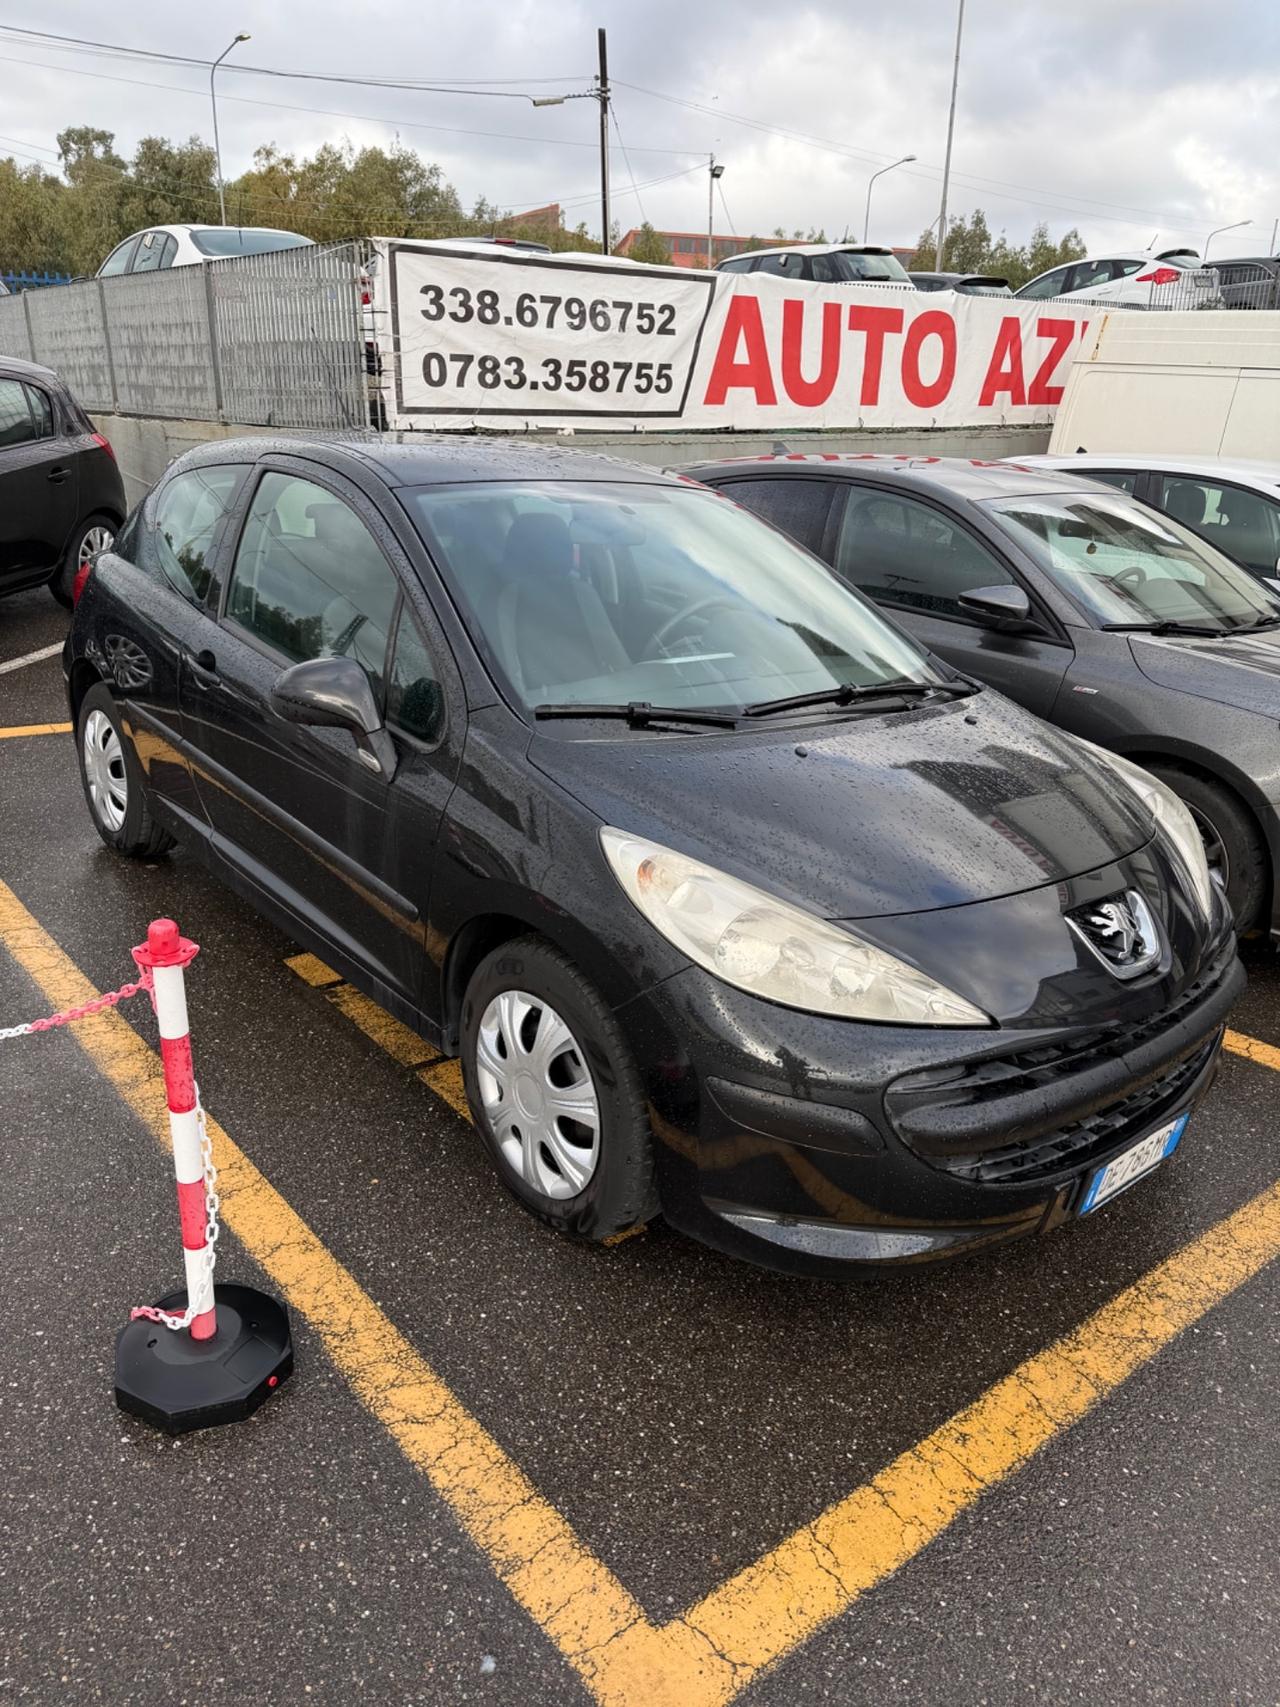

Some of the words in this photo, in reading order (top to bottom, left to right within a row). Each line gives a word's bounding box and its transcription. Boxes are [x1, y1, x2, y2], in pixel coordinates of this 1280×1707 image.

[420, 285, 675, 335] 338.6796752
[422, 352, 673, 394] 0783.358755
[703, 295, 957, 408] AUTO
[978, 316, 1089, 406] AZ
